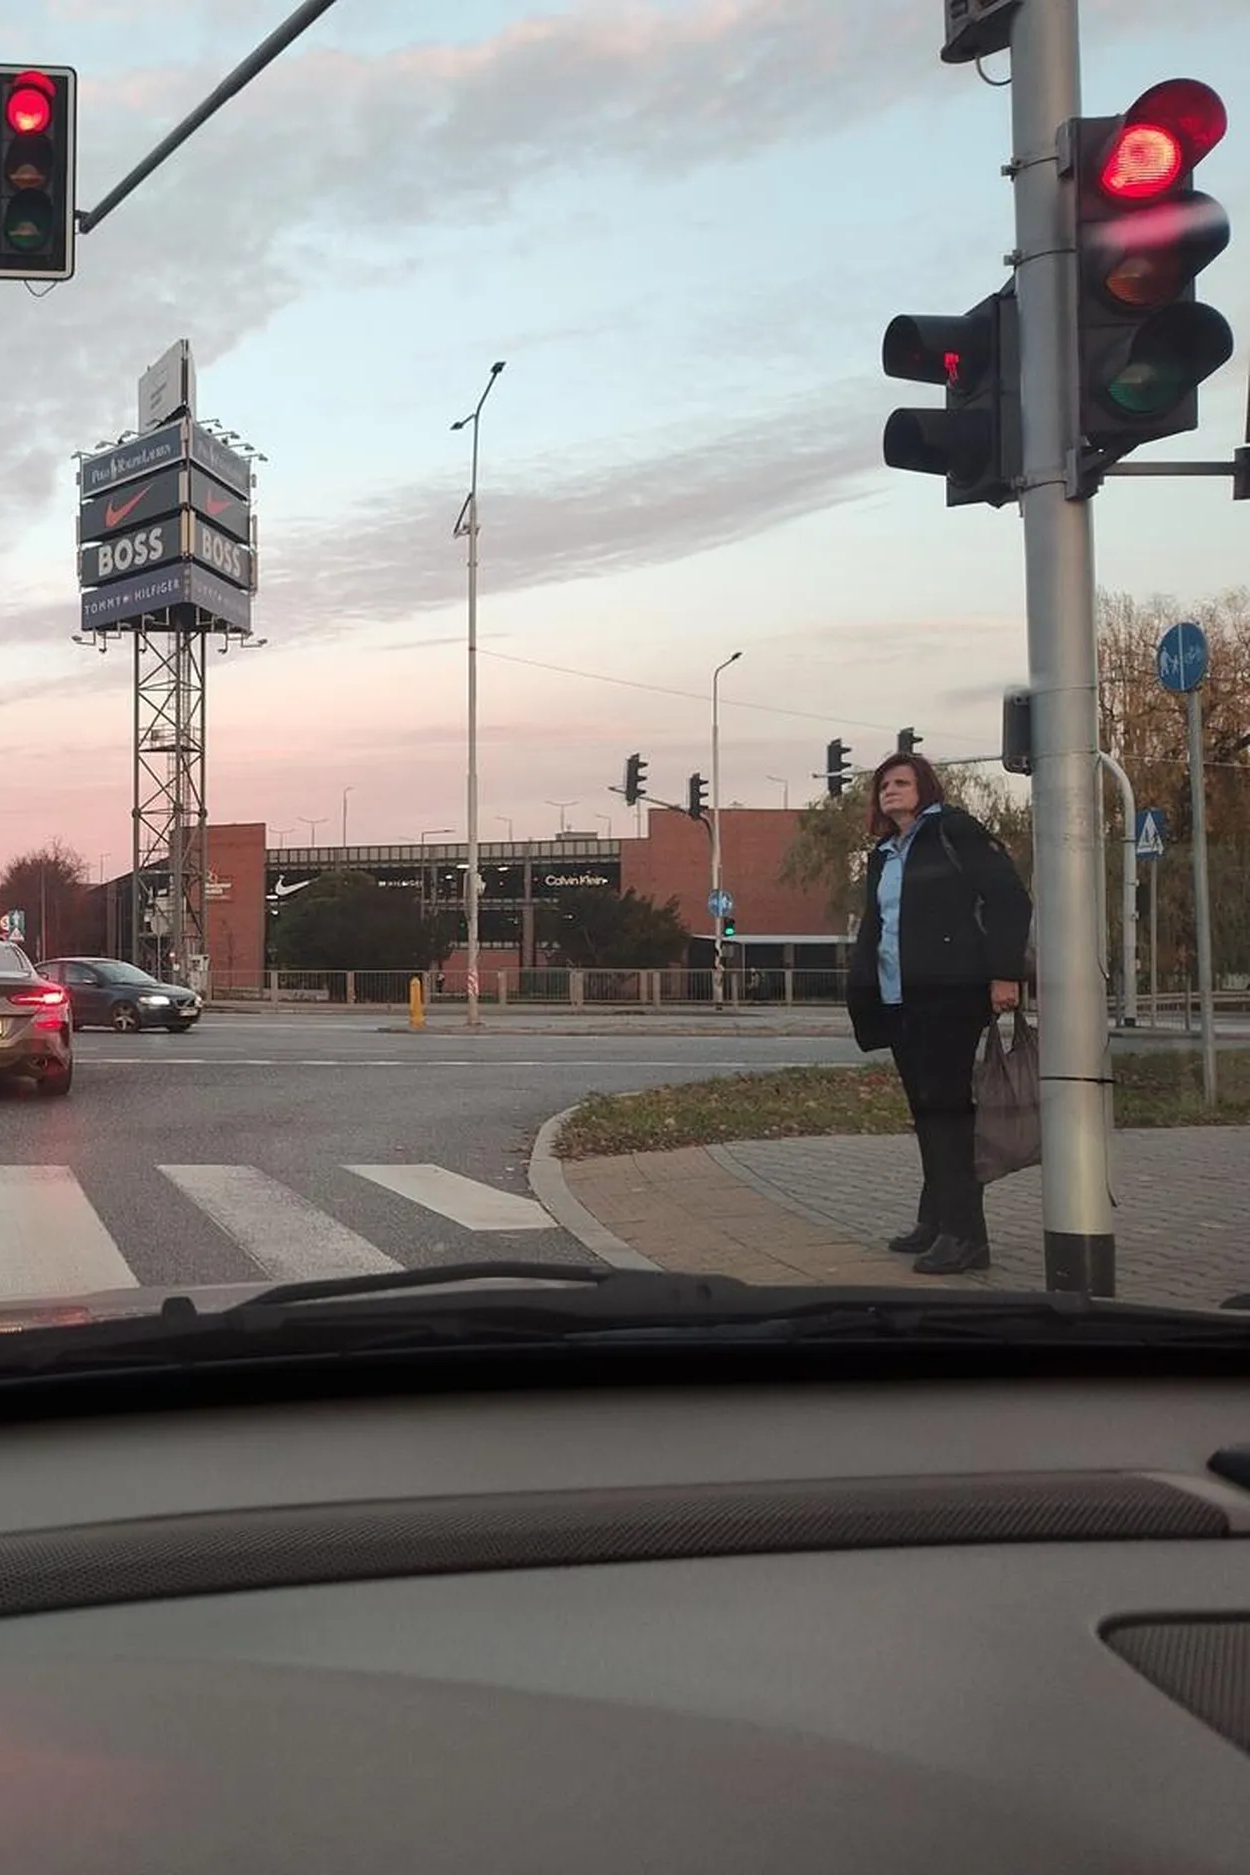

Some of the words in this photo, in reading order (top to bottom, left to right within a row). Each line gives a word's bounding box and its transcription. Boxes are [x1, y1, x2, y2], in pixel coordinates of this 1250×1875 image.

[99, 527, 163, 577] BOSS
[202, 528, 241, 578] BOSS
[134, 578, 180, 601] HILFIGER
[545, 875, 579, 886] Calvin
